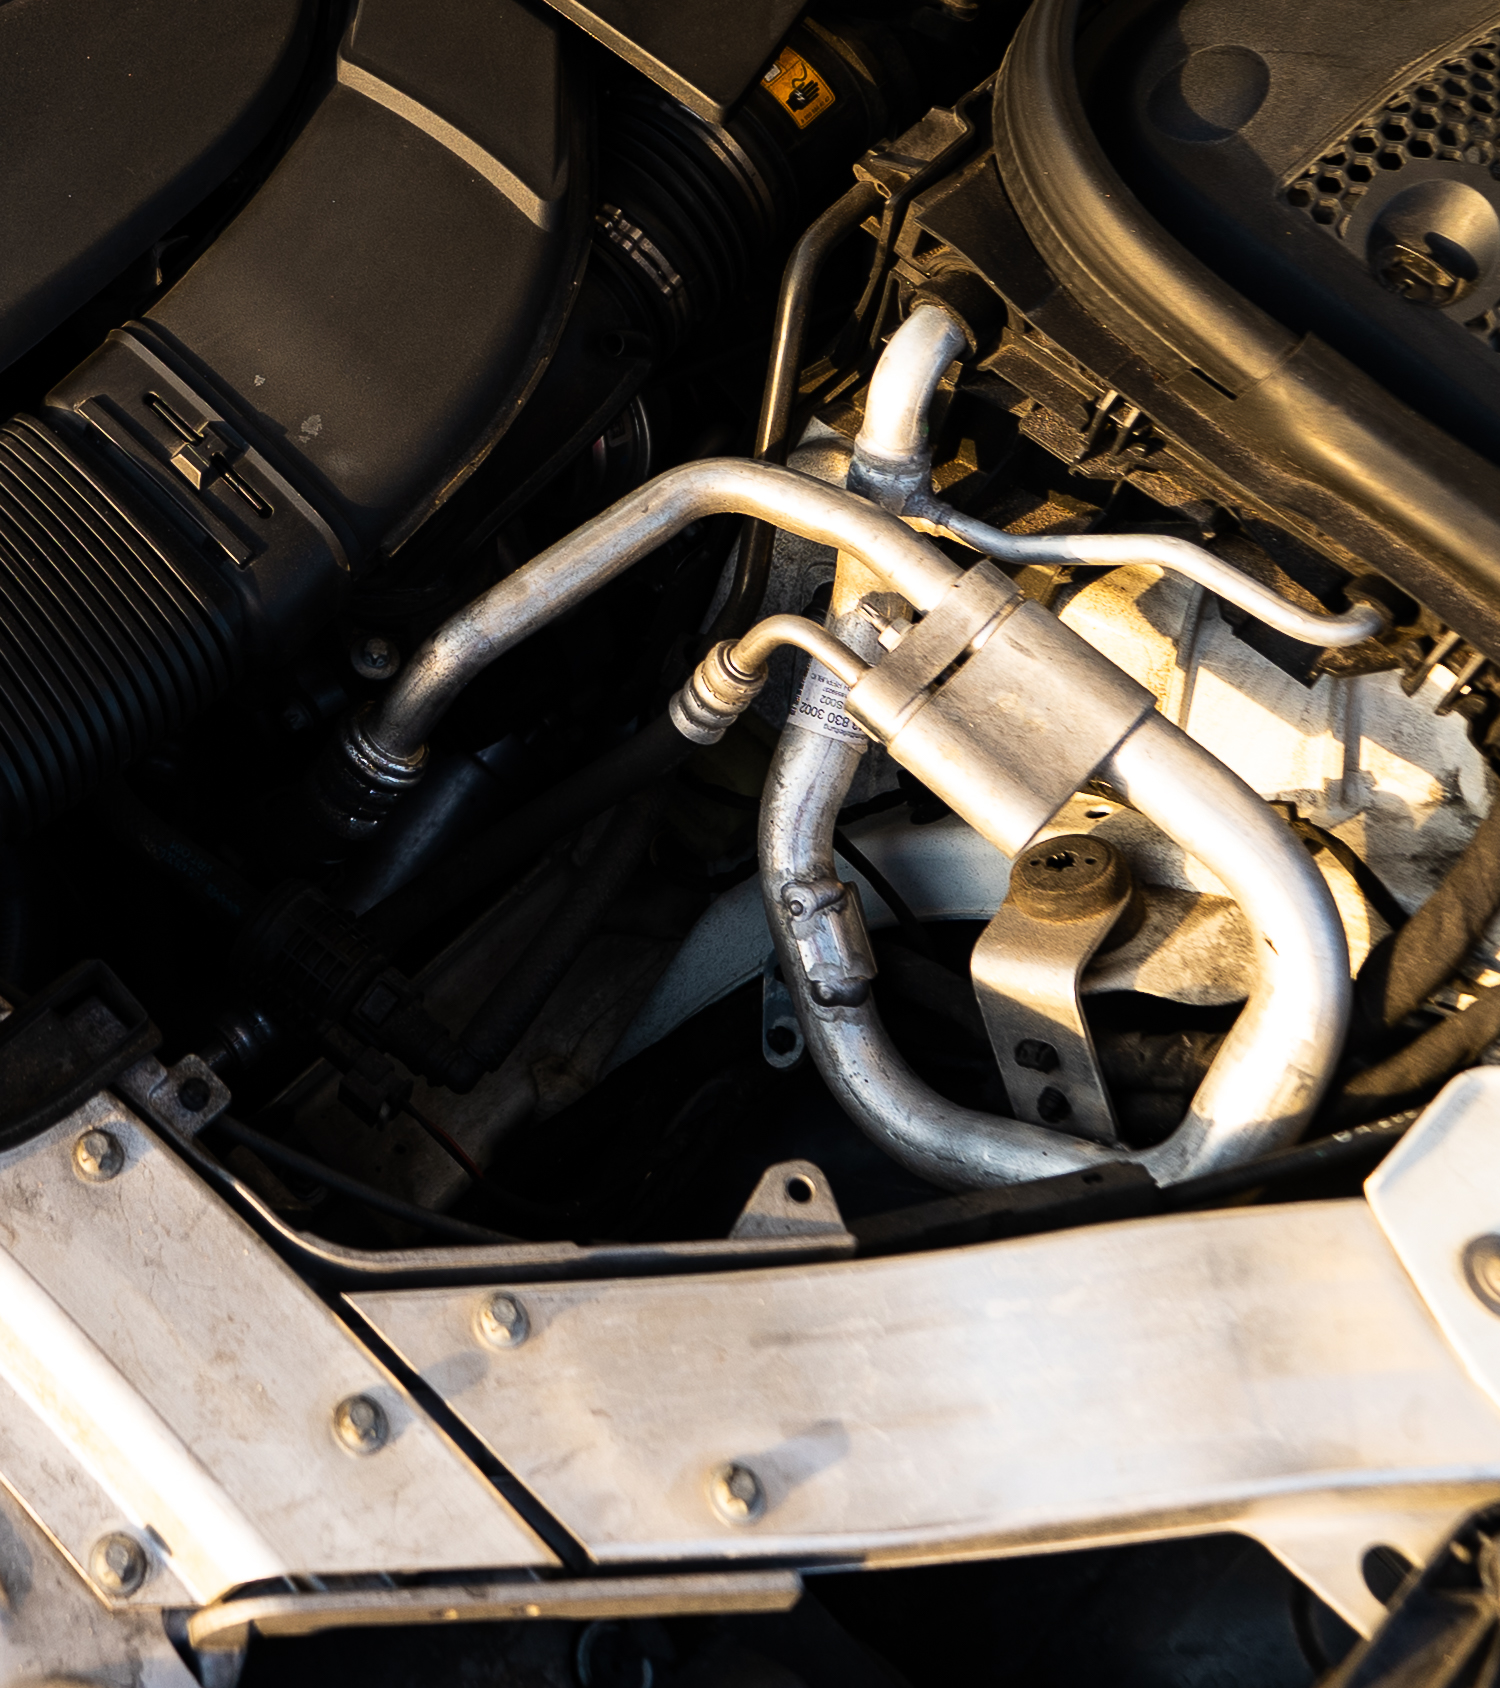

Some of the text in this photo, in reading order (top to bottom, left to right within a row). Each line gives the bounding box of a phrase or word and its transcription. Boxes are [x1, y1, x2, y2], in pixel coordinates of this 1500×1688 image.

[819, 694, 844, 710] S002
[799, 701, 826, 720] 3002
[827, 712, 850, 728] 830
